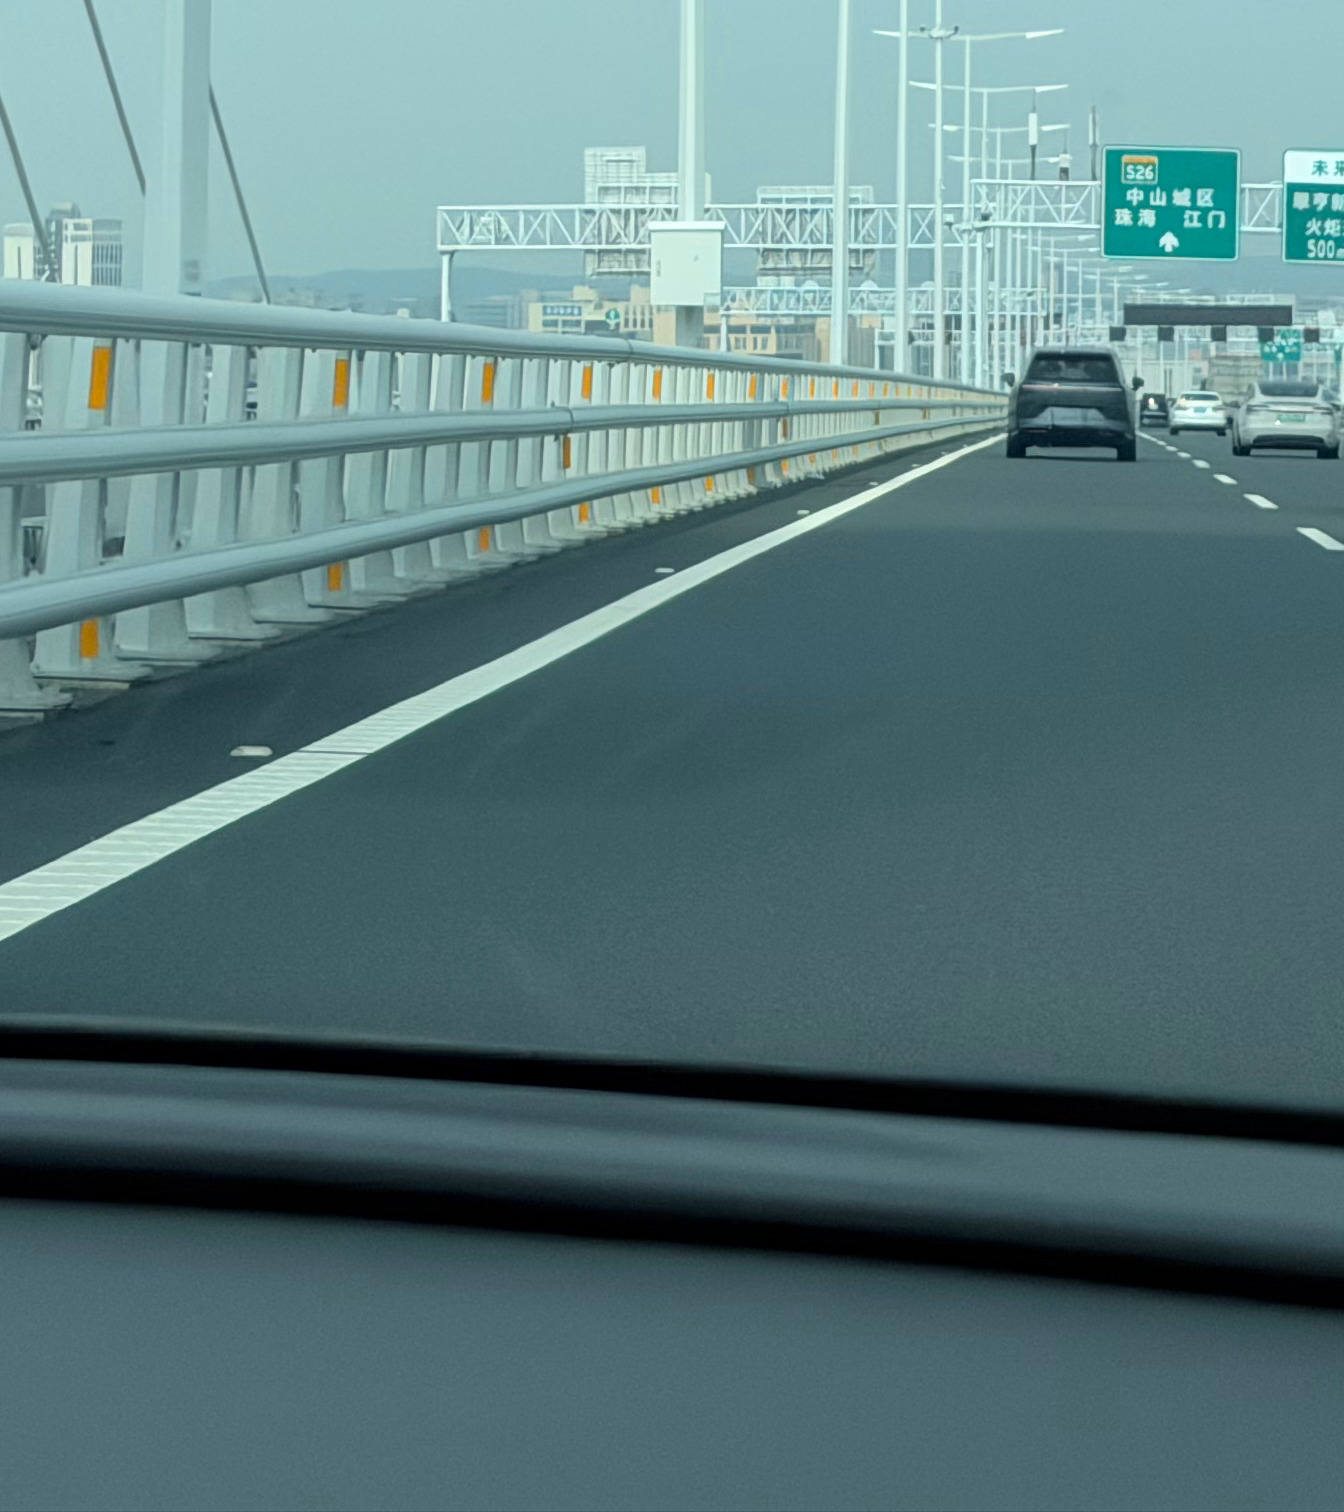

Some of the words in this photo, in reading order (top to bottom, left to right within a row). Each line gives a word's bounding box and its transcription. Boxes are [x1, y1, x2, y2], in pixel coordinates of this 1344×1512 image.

[1126, 164, 1154, 180] S26
[1125, 186, 1215, 208] 中山城区
[1113, 207, 1157, 228] 珠海
[1182, 209, 1226, 229] 江门
